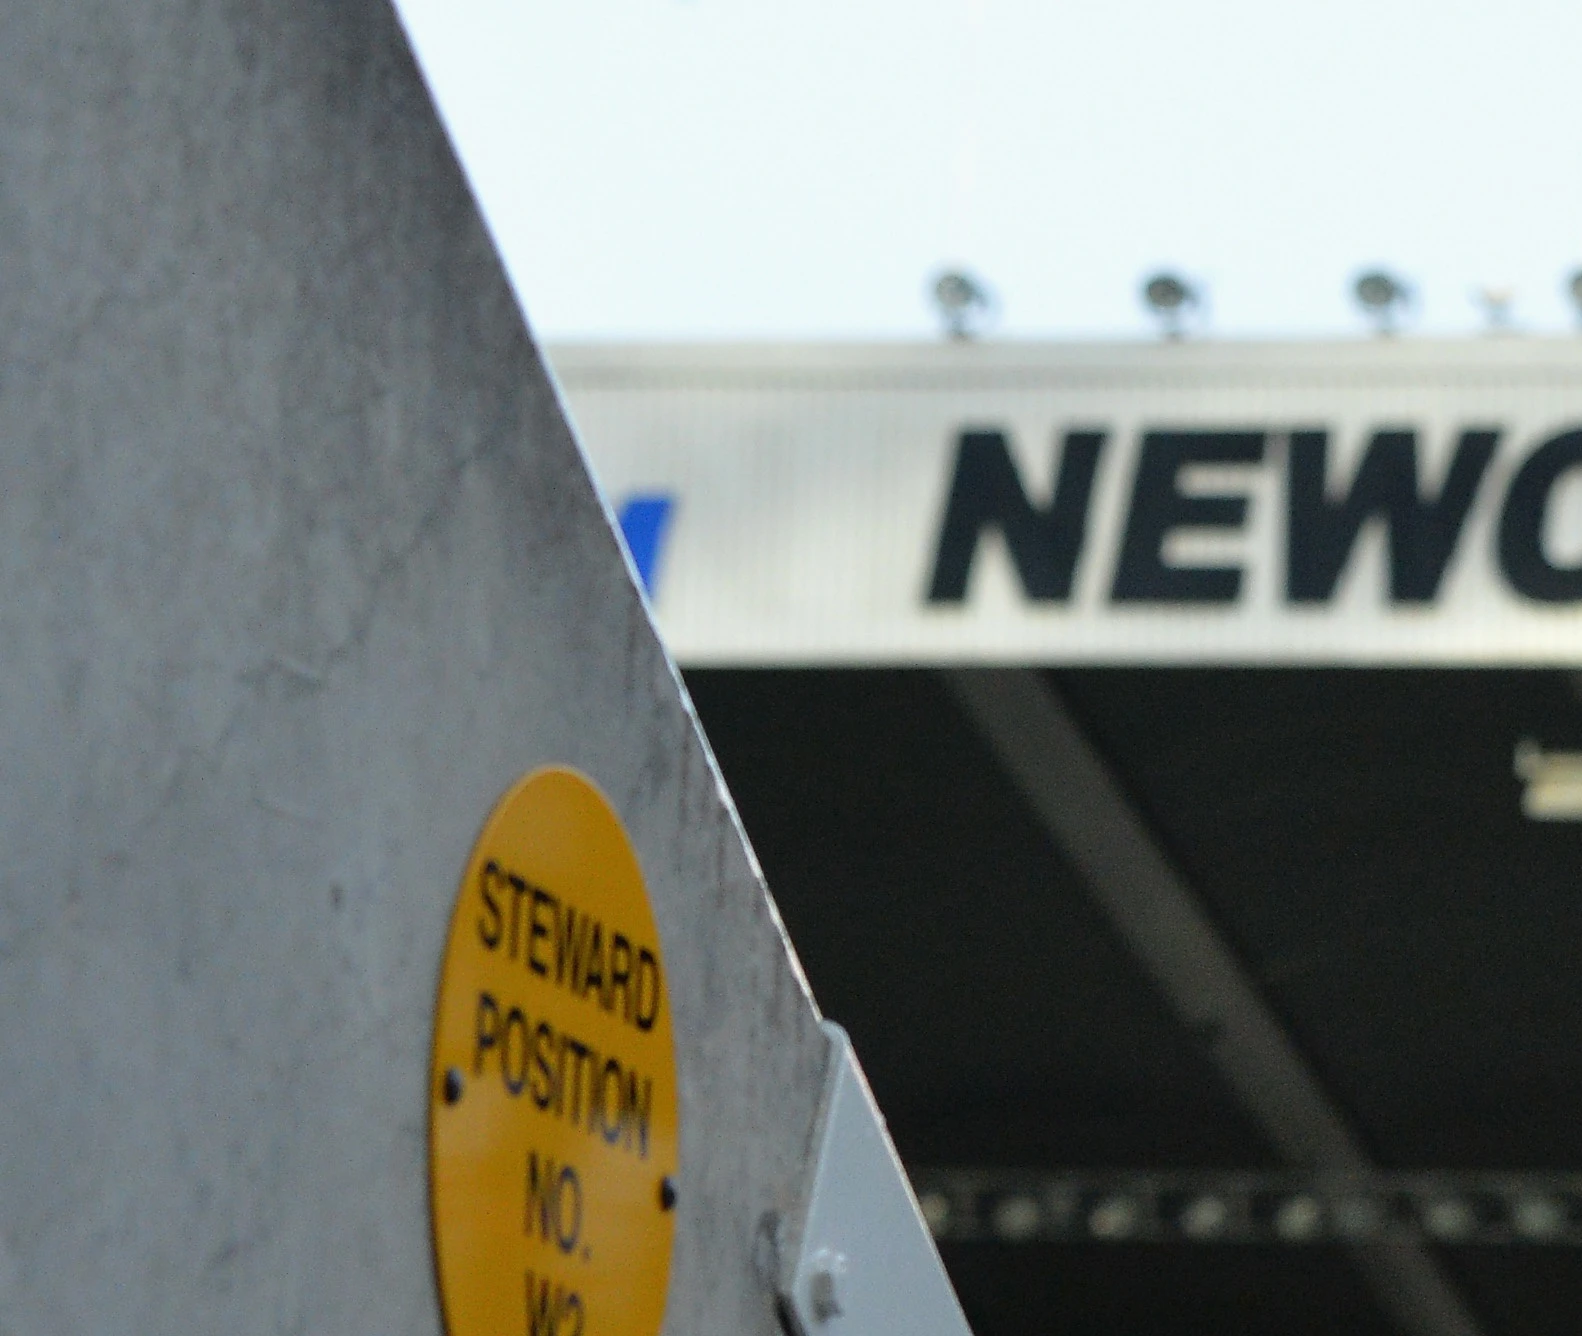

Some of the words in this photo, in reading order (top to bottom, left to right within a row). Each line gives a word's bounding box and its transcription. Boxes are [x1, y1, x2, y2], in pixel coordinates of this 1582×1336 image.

[476, 859, 659, 1034] STEWARD
[475, 992, 652, 1160] POSITION
[525, 1151, 590, 1262] NO.
